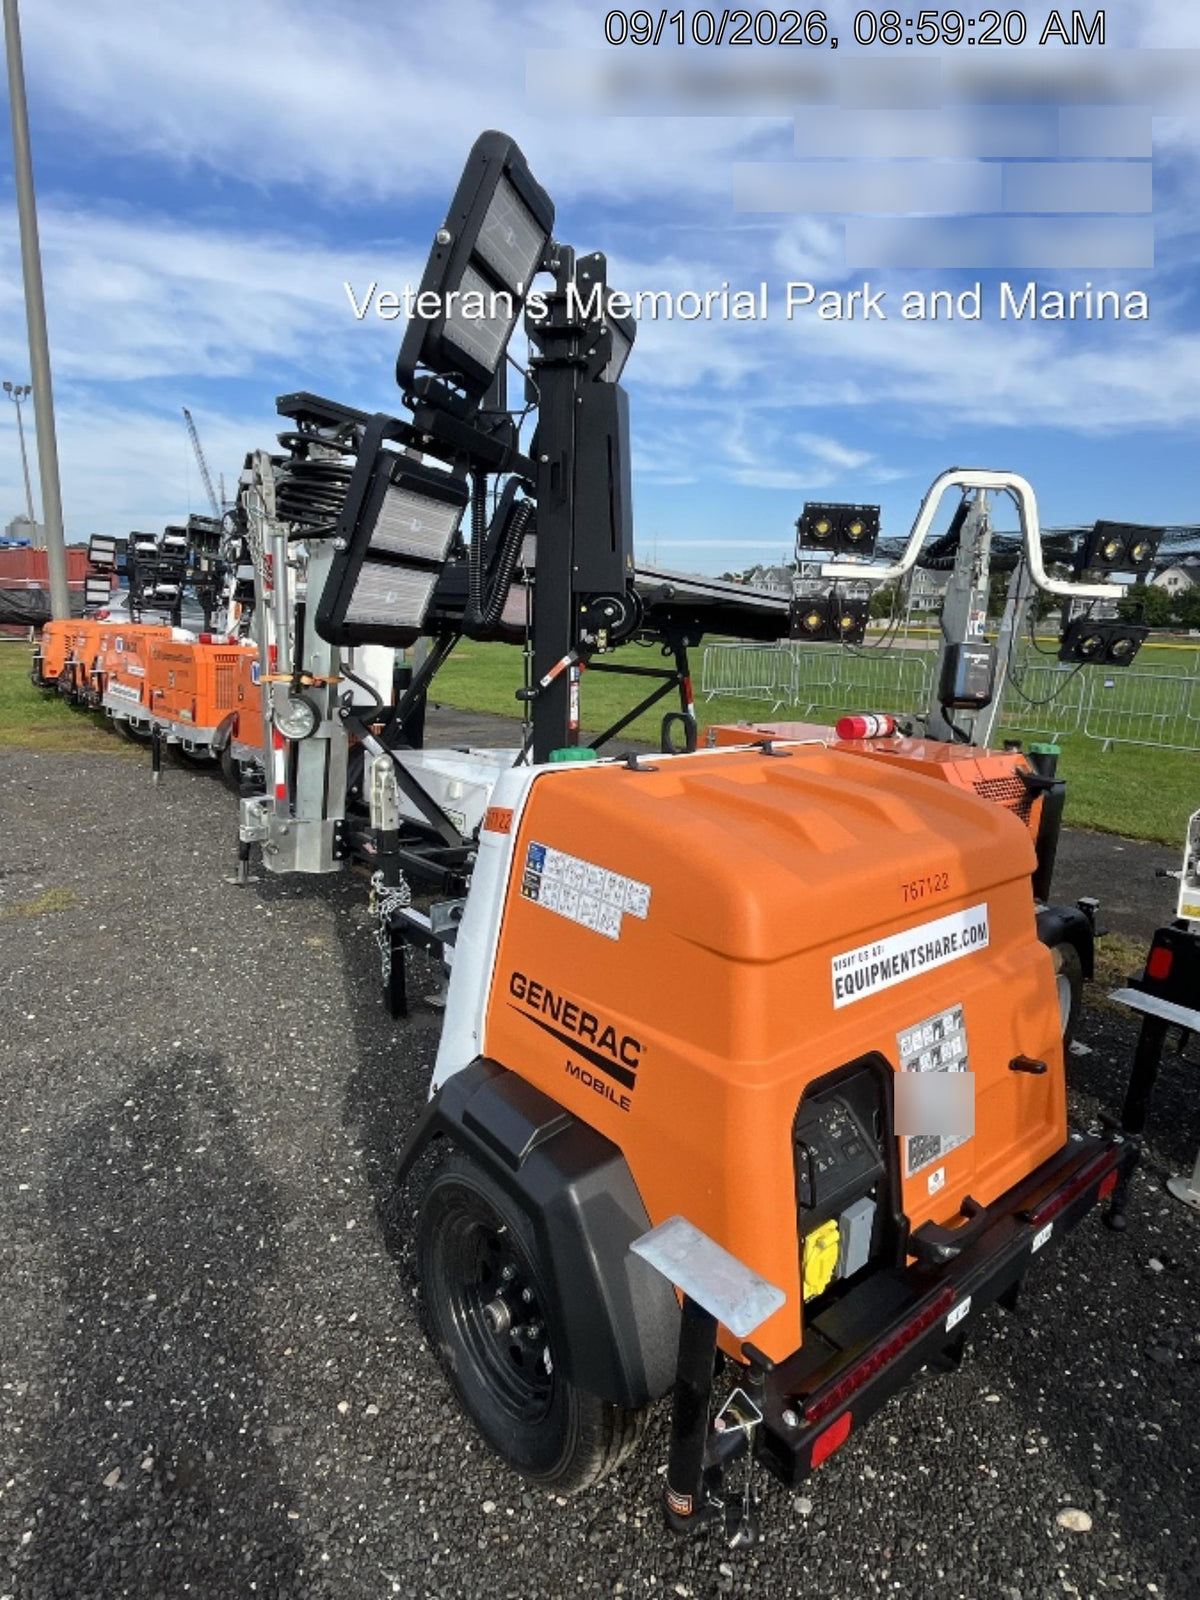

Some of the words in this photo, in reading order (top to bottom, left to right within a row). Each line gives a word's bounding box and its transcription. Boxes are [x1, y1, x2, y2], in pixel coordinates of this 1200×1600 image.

[901, 872, 950, 903] 767122
[833, 954, 855, 972] VISIT
[834, 922, 988, 1000] EQUIPMENTSHARE.COM
[509, 971, 641, 1069] GENERAC
[565, 1060, 632, 1113] MOBILE
